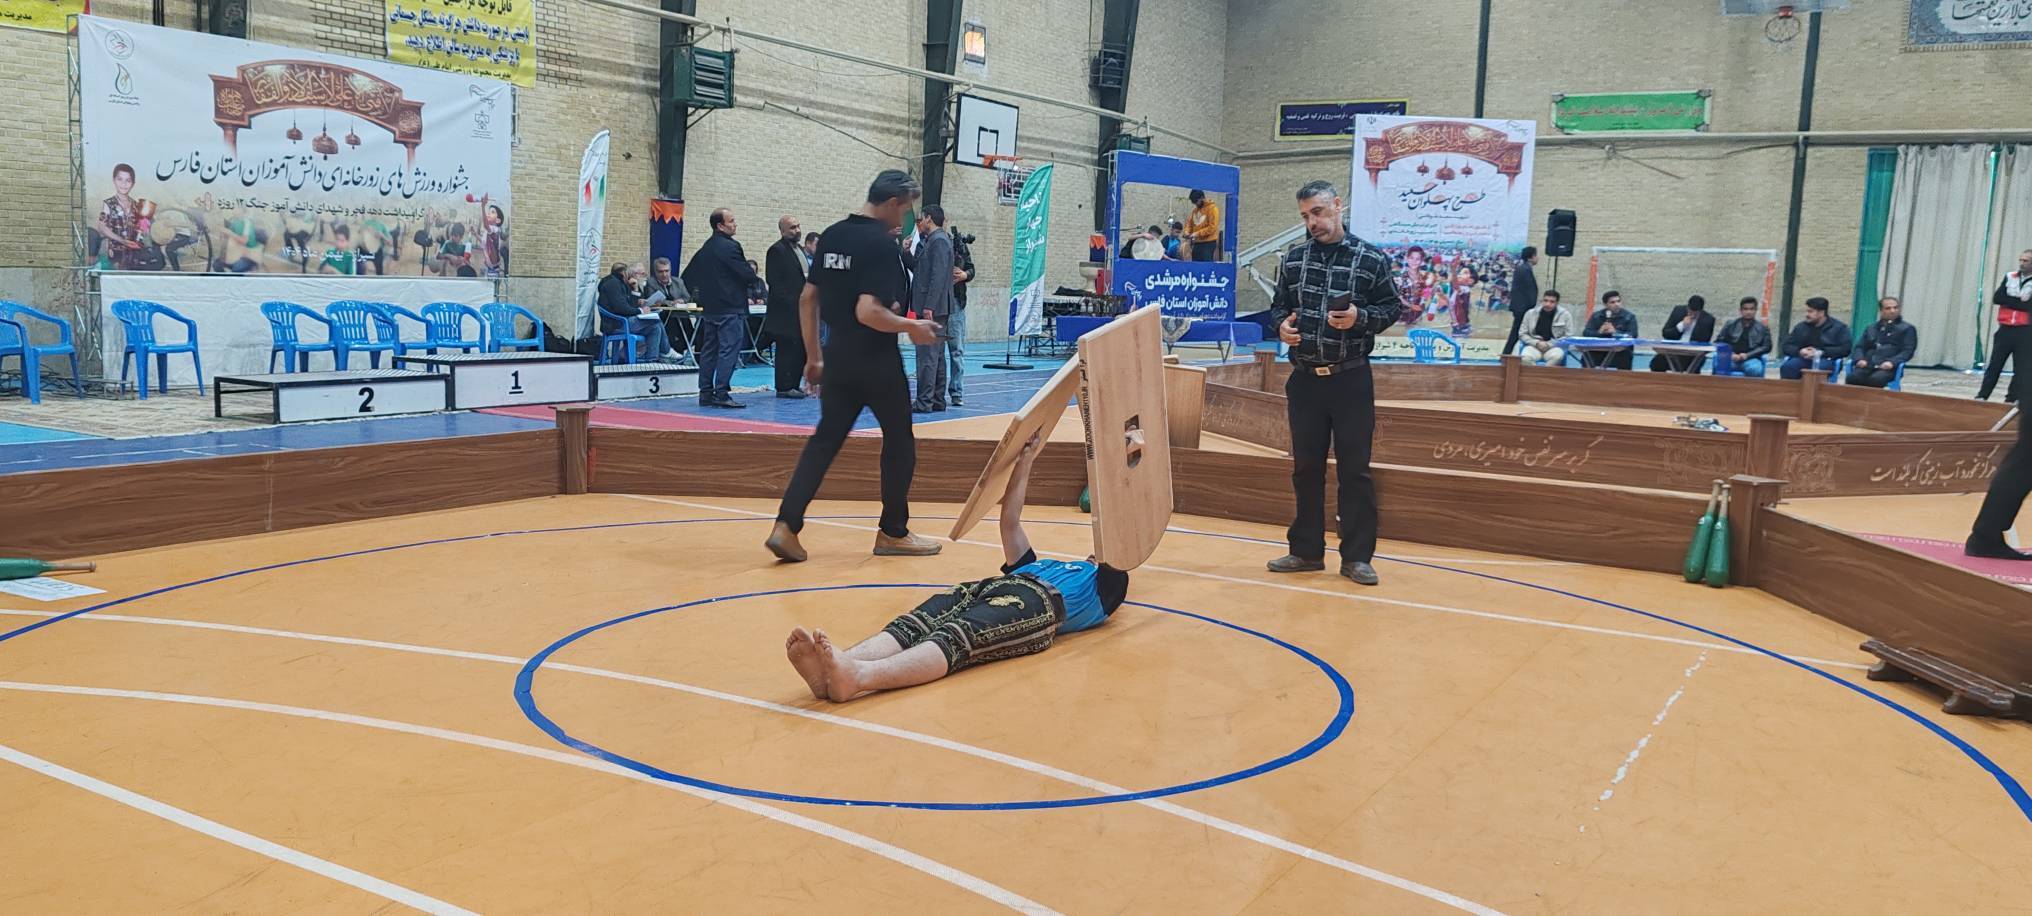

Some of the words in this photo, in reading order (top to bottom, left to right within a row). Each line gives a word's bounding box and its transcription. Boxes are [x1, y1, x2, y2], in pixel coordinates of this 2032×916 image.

[418, 8, 437, 28] مشکل
[463, 17, 481, 35] داشتن
[482, 24, 500, 40] صورت
[155, 151, 201, 182] فارس
[200, 154, 242, 184] استان
[241, 155, 296, 187] آموزان
[288, 155, 323, 191] دانش
[401, 167, 435, 199] ورزش
[437, 164, 469, 194] جشنواره
[217, 198, 235, 211] روزه
[245, 198, 269, 210] جنگ
[271, 198, 289, 213] آموز
[290, 200, 314, 214] دانش
[1407, 193, 1454, 212] پهلوان
[1451, 188, 1486, 211] طرح
[315, 202, 344, 216] شهدای
[350, 204, 366, 217] فجر
[367, 208, 383, 217] دهه
[383, 207, 426, 221] گرامیداشت
[1145, 269, 1182, 291] مرشدی
[1181, 271, 1229, 289] جشنواره
[1166, 297, 1187, 310] استان
[1187, 295, 1210, 312] آموزان
[1210, 295, 1228, 311] دانش
[510, 370, 522, 390] 1
[648, 377, 660, 394] 3
[358, 387, 375, 413] 2
